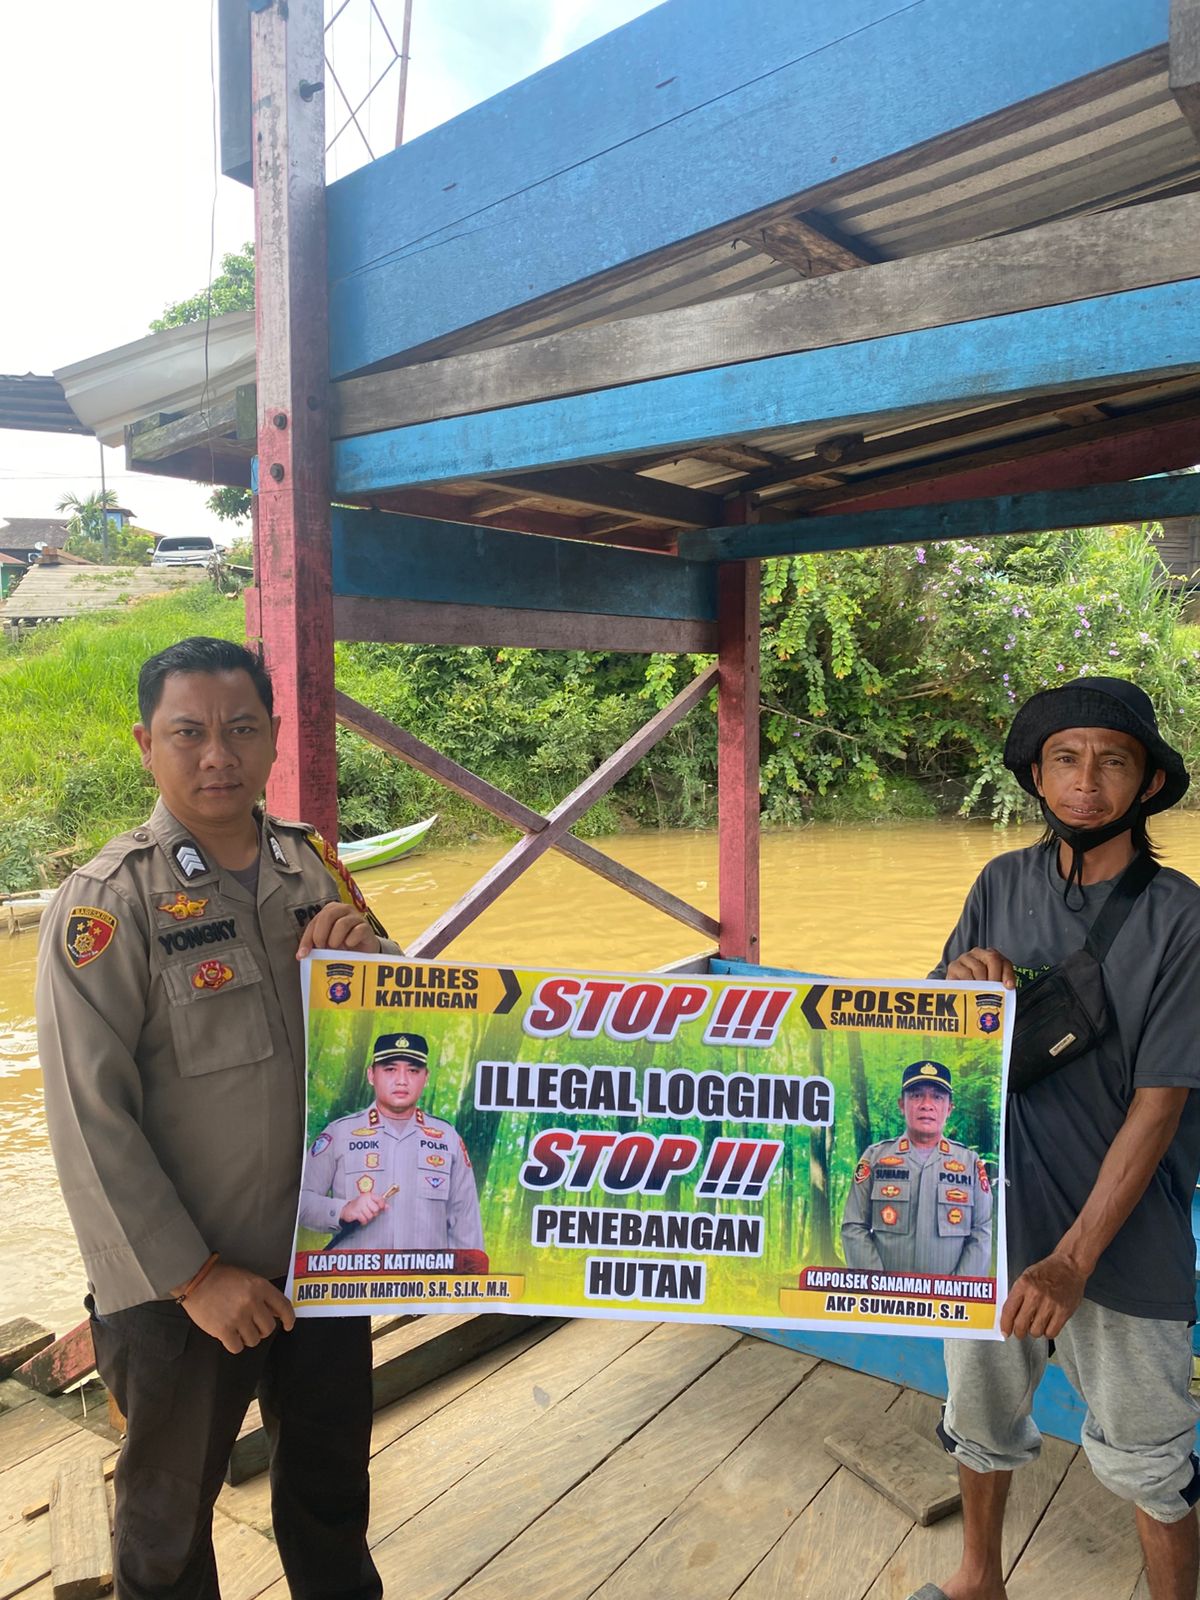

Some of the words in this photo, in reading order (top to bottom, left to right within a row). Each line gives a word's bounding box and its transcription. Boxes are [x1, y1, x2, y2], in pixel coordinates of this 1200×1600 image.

[158, 919, 237, 955] YONGKY
[376, 965, 479, 990] POLRES
[375, 990, 478, 1009] KATINGAN
[528, 978, 709, 1036] STOP
[709, 988, 792, 1041] !!!
[831, 989, 959, 1017] POLSEK
[830, 1012, 894, 1028] SANAMAN
[896, 1015, 959, 1032] MANTIKEI
[478, 1065, 638, 1113] ILLEGAL
[648, 1072, 830, 1123] LOGGING
[349, 1141, 379, 1151] DODIK
[420, 1140, 448, 1151] POLRI
[523, 1131, 698, 1192] STOP
[699, 1141, 780, 1197] !!!
[939, 1172, 971, 1184] POLRI
[536, 1209, 761, 1253] PENEBANGAN
[307, 1254, 381, 1272] KAPOLRES
[384, 1253, 455, 1270] KATINGAN
[297, 1283, 329, 1300] AKBP
[331, 1282, 367, 1299] DODIK
[370, 1281, 426, 1298] HARTONO,
[486, 1281, 510, 1297] M.H.
[589, 1261, 702, 1300] HUTAN
[806, 1271, 869, 1290] KAPOLSEK
[871, 1274, 931, 1294] SANAMAN
[933, 1279, 993, 1298] MANTIKEI
[826, 1295, 857, 1312] AKP
[860, 1297, 936, 1319] SUWARDI,
[940, 1304, 969, 1320] S.H.
